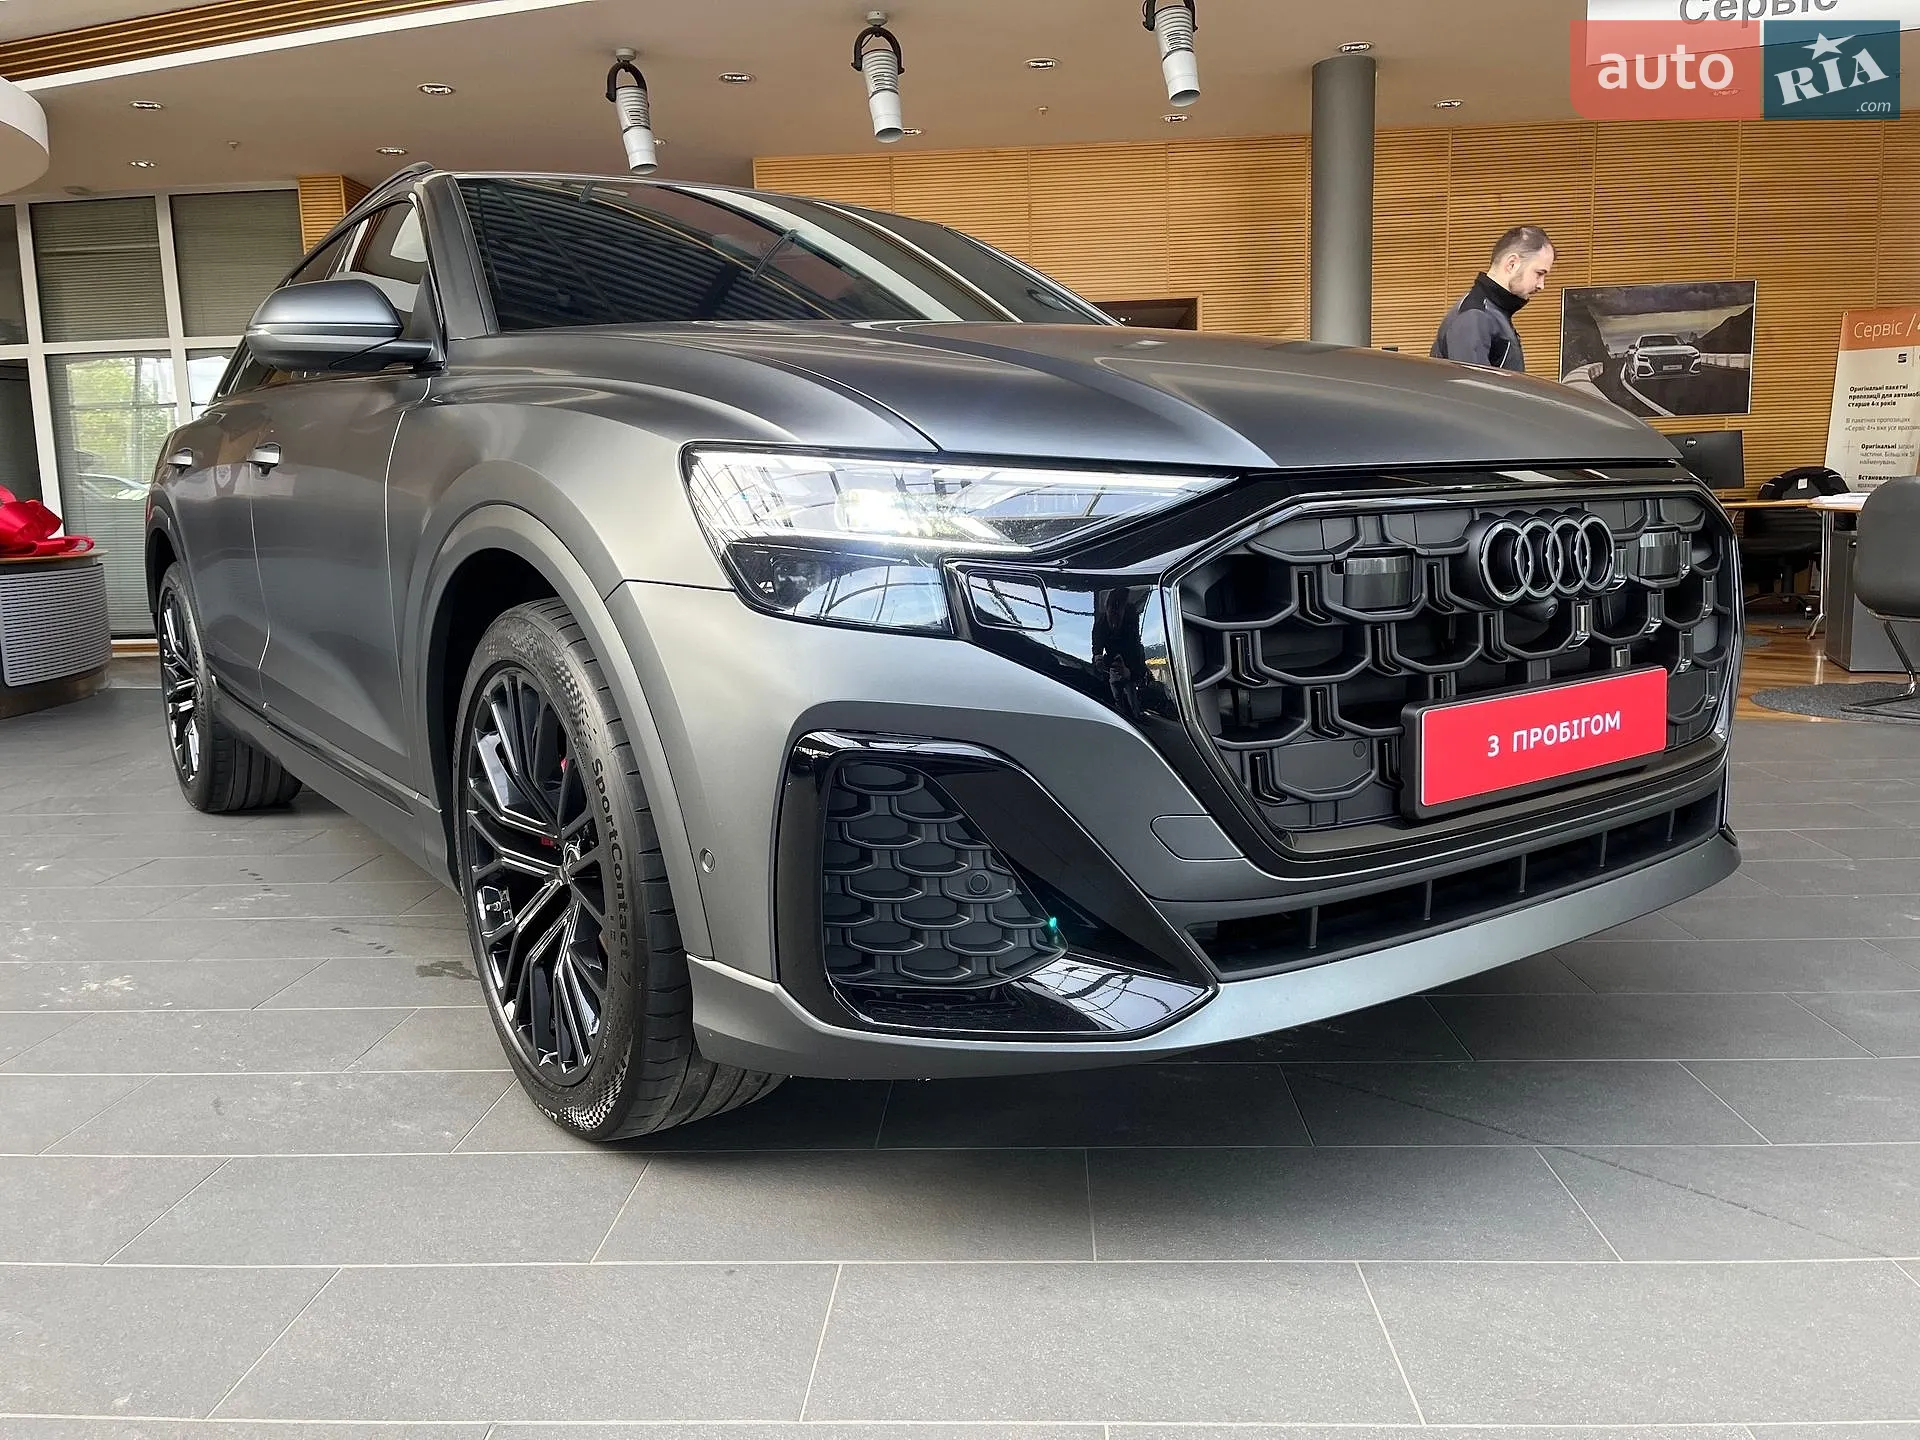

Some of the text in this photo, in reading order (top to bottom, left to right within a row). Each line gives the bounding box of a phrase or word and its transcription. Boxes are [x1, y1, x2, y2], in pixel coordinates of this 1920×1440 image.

[1854, 319, 1903, 342] Сервіс
[1512, 710, 1621, 752] ПРОБІГОМ
[592, 758, 631, 960] SportContact
